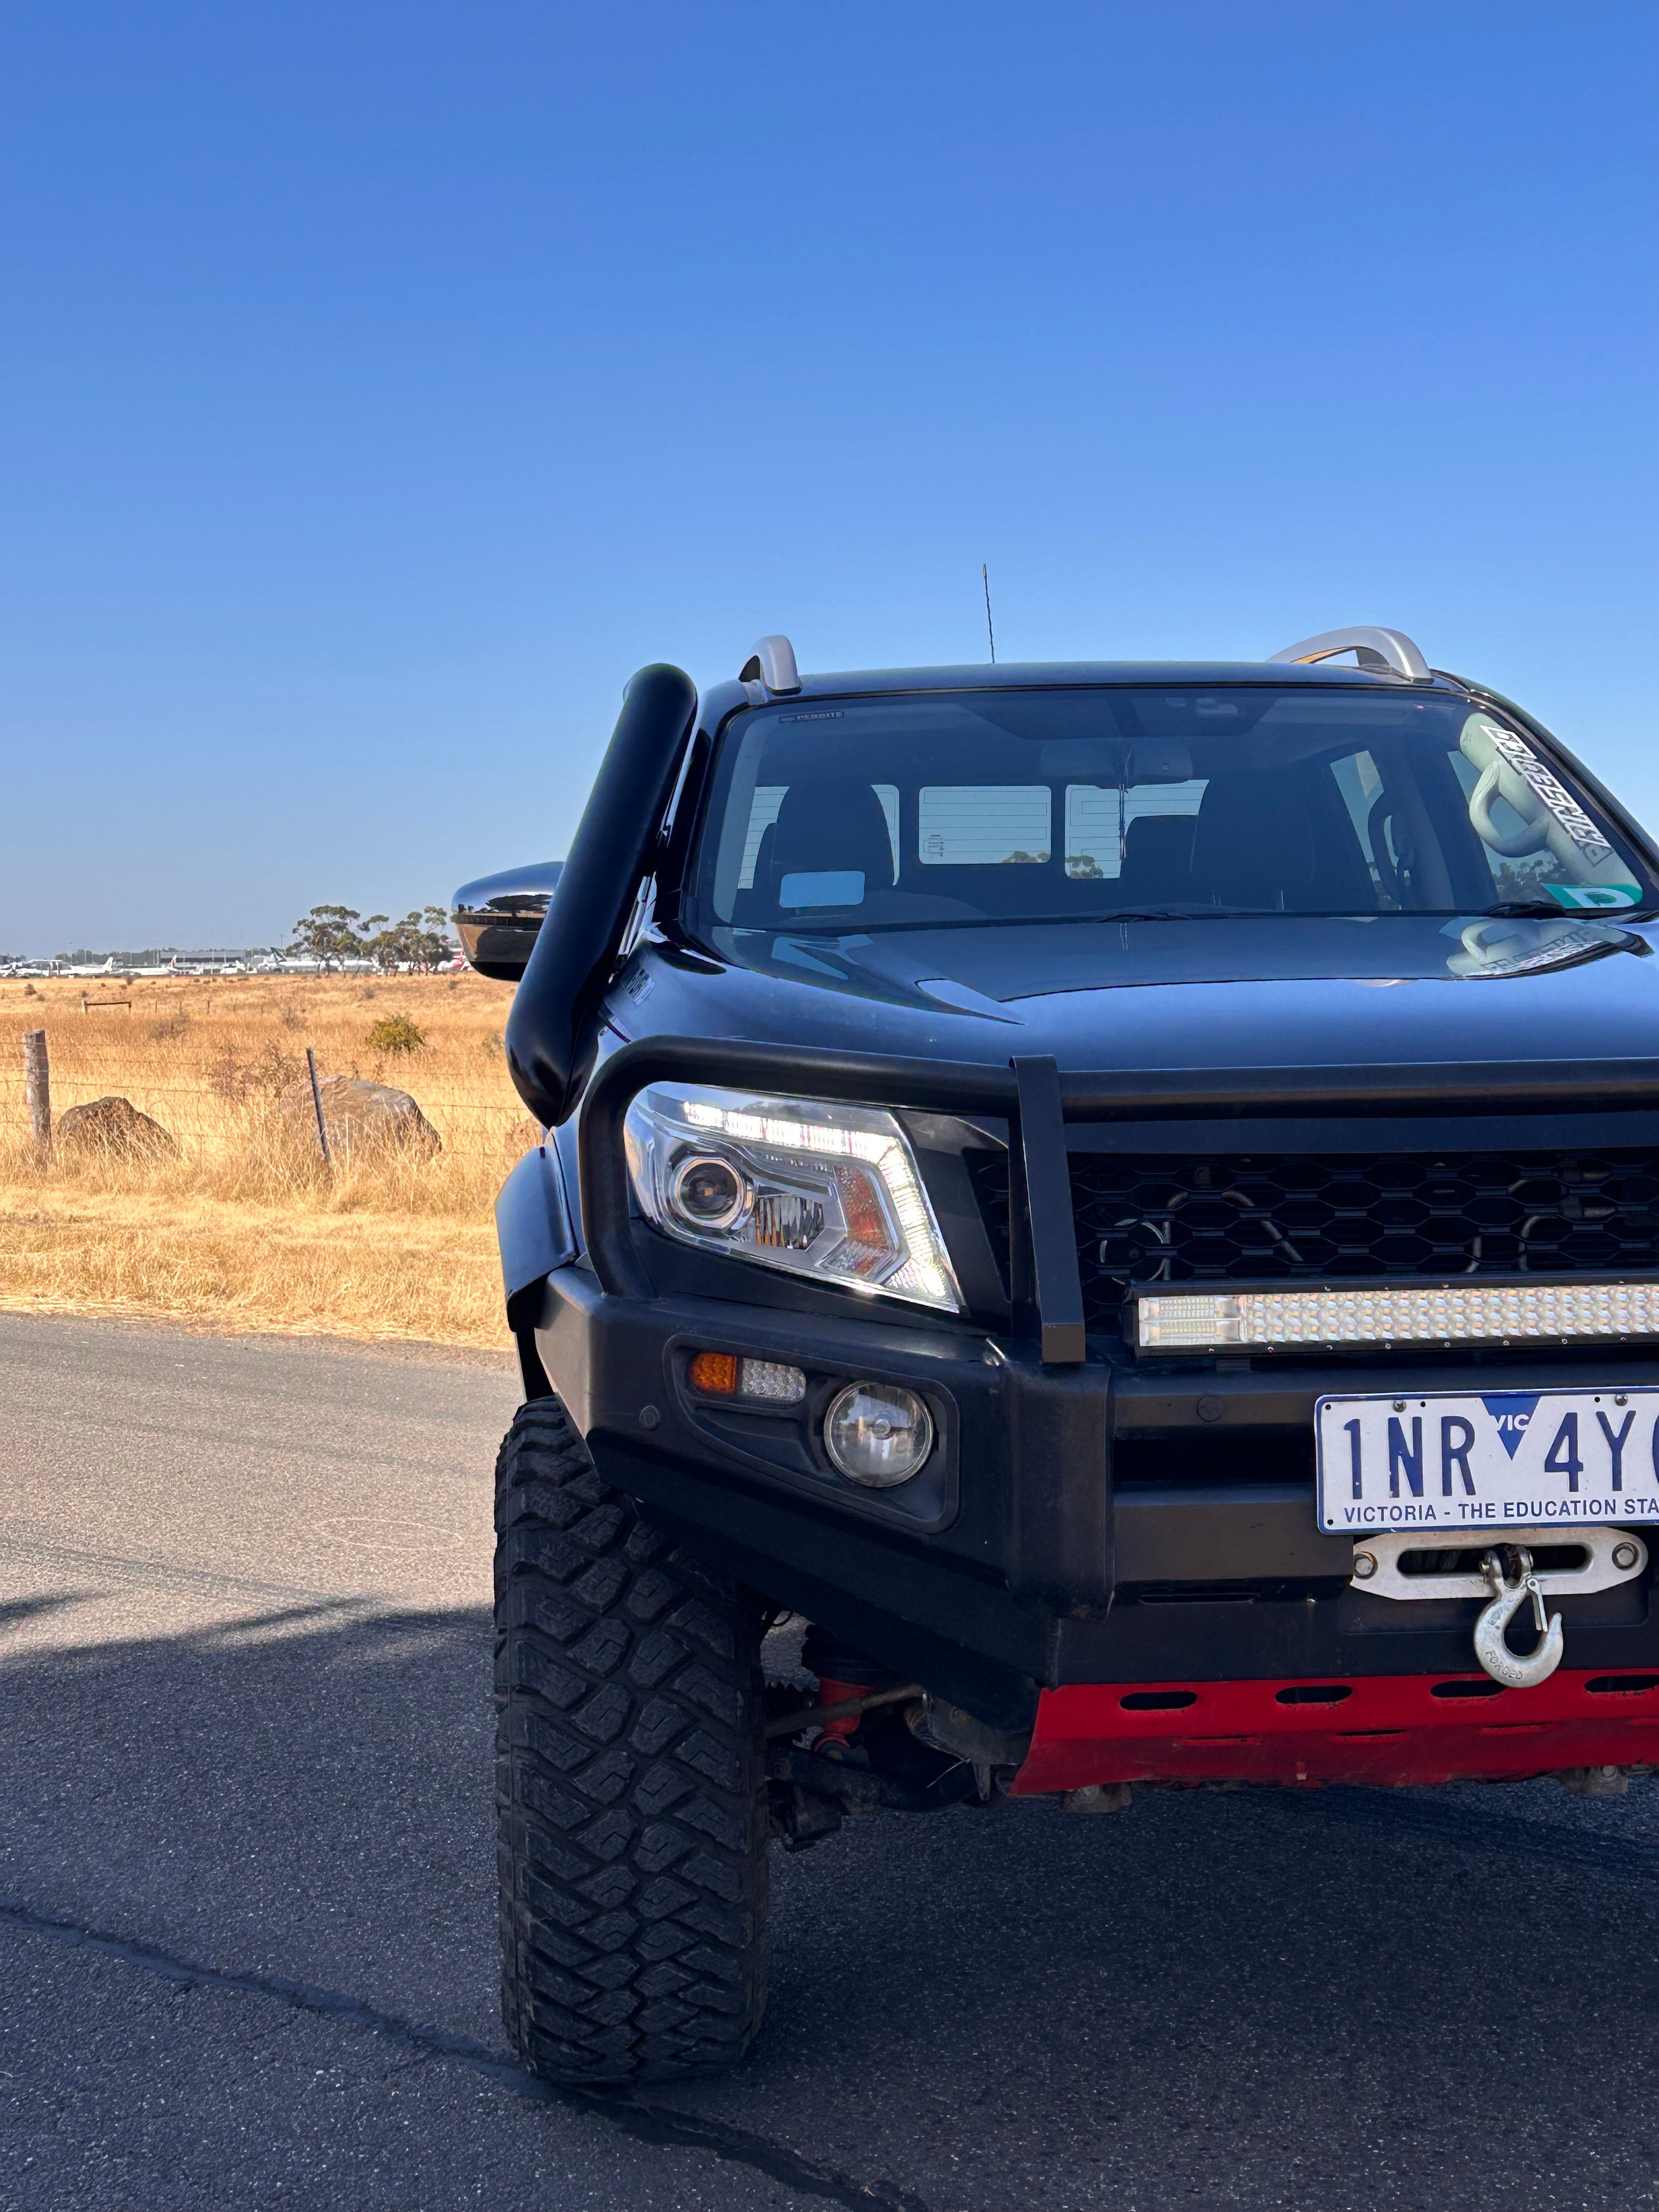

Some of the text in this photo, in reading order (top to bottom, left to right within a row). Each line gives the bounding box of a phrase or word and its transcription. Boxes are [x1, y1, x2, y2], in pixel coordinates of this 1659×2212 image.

[1491, 1413, 1530, 1431] VIC
[1344, 1410, 1659, 1500] 1NR 4Y
[1344, 1504, 1437, 1523] VICTORIA
[1458, 1503, 1496, 1519] THE
[1503, 1498, 1617, 1519] EDUCATION
